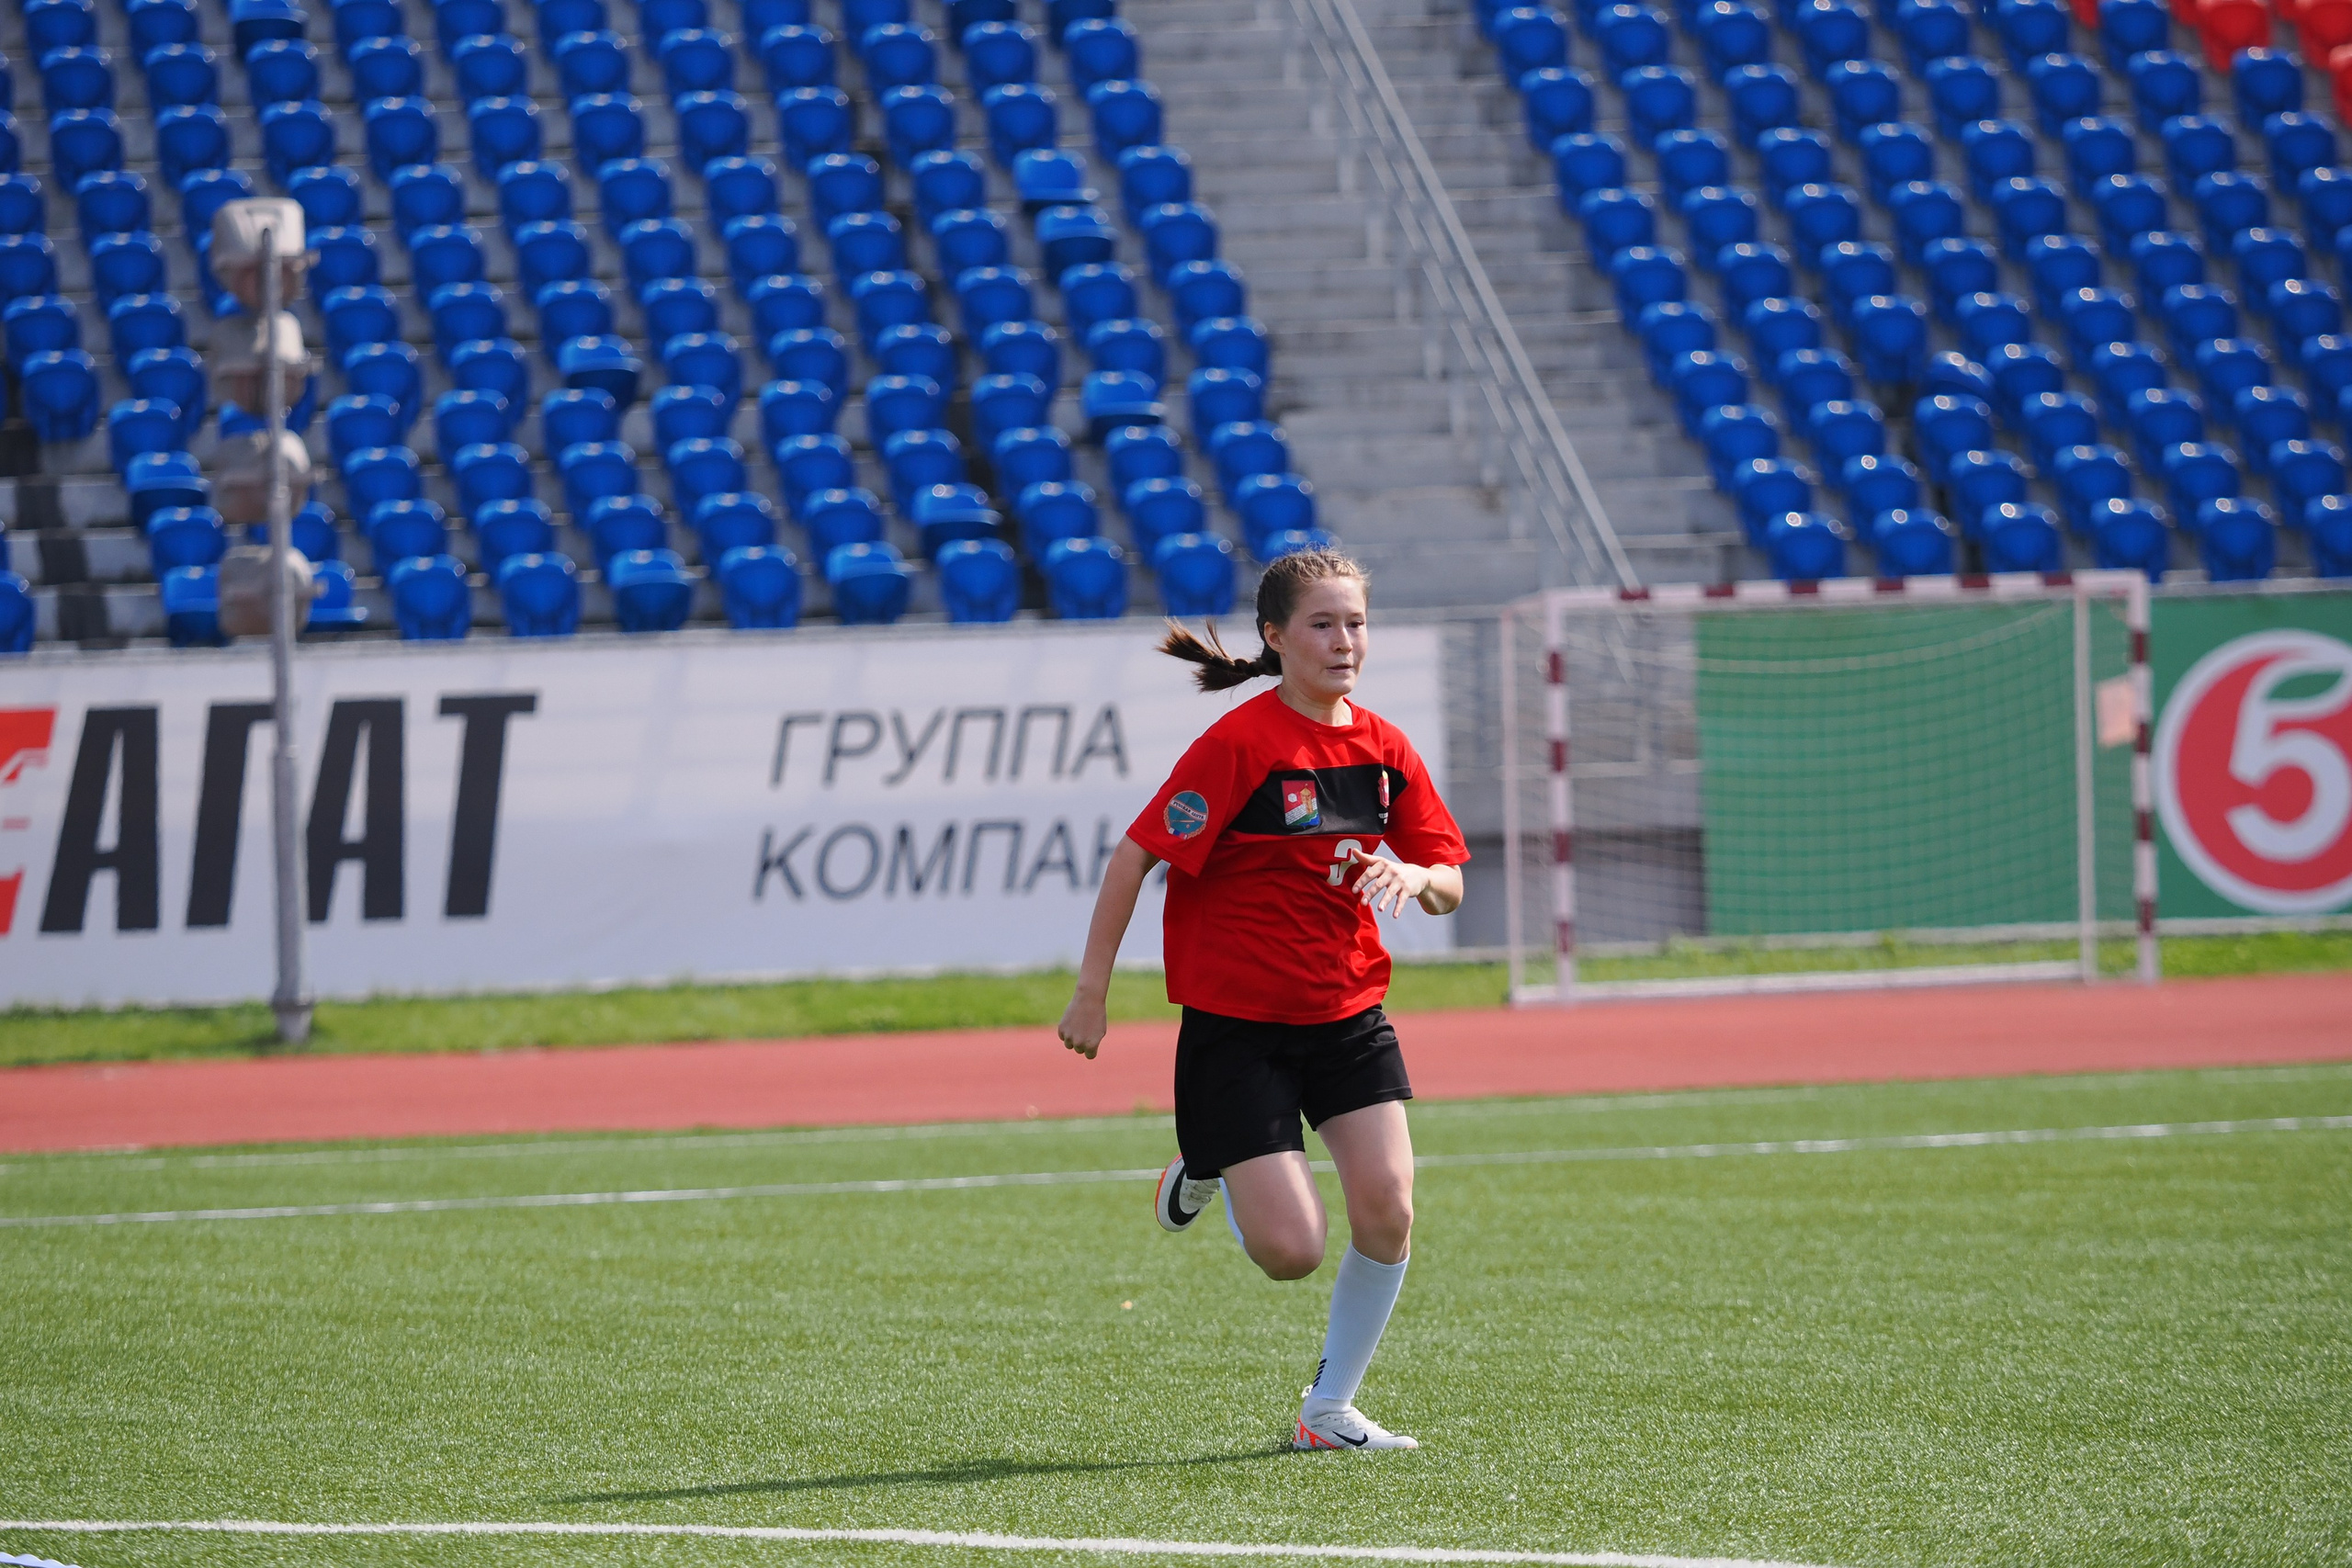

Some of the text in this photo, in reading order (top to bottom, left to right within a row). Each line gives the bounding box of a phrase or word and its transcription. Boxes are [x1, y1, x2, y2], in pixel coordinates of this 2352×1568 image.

[40, 694, 538, 932] АГАТ
[769, 703, 1129, 788] ГРУППА
[2225, 652, 2352, 864] 5
[752, 815, 1167, 901] КОМПА
